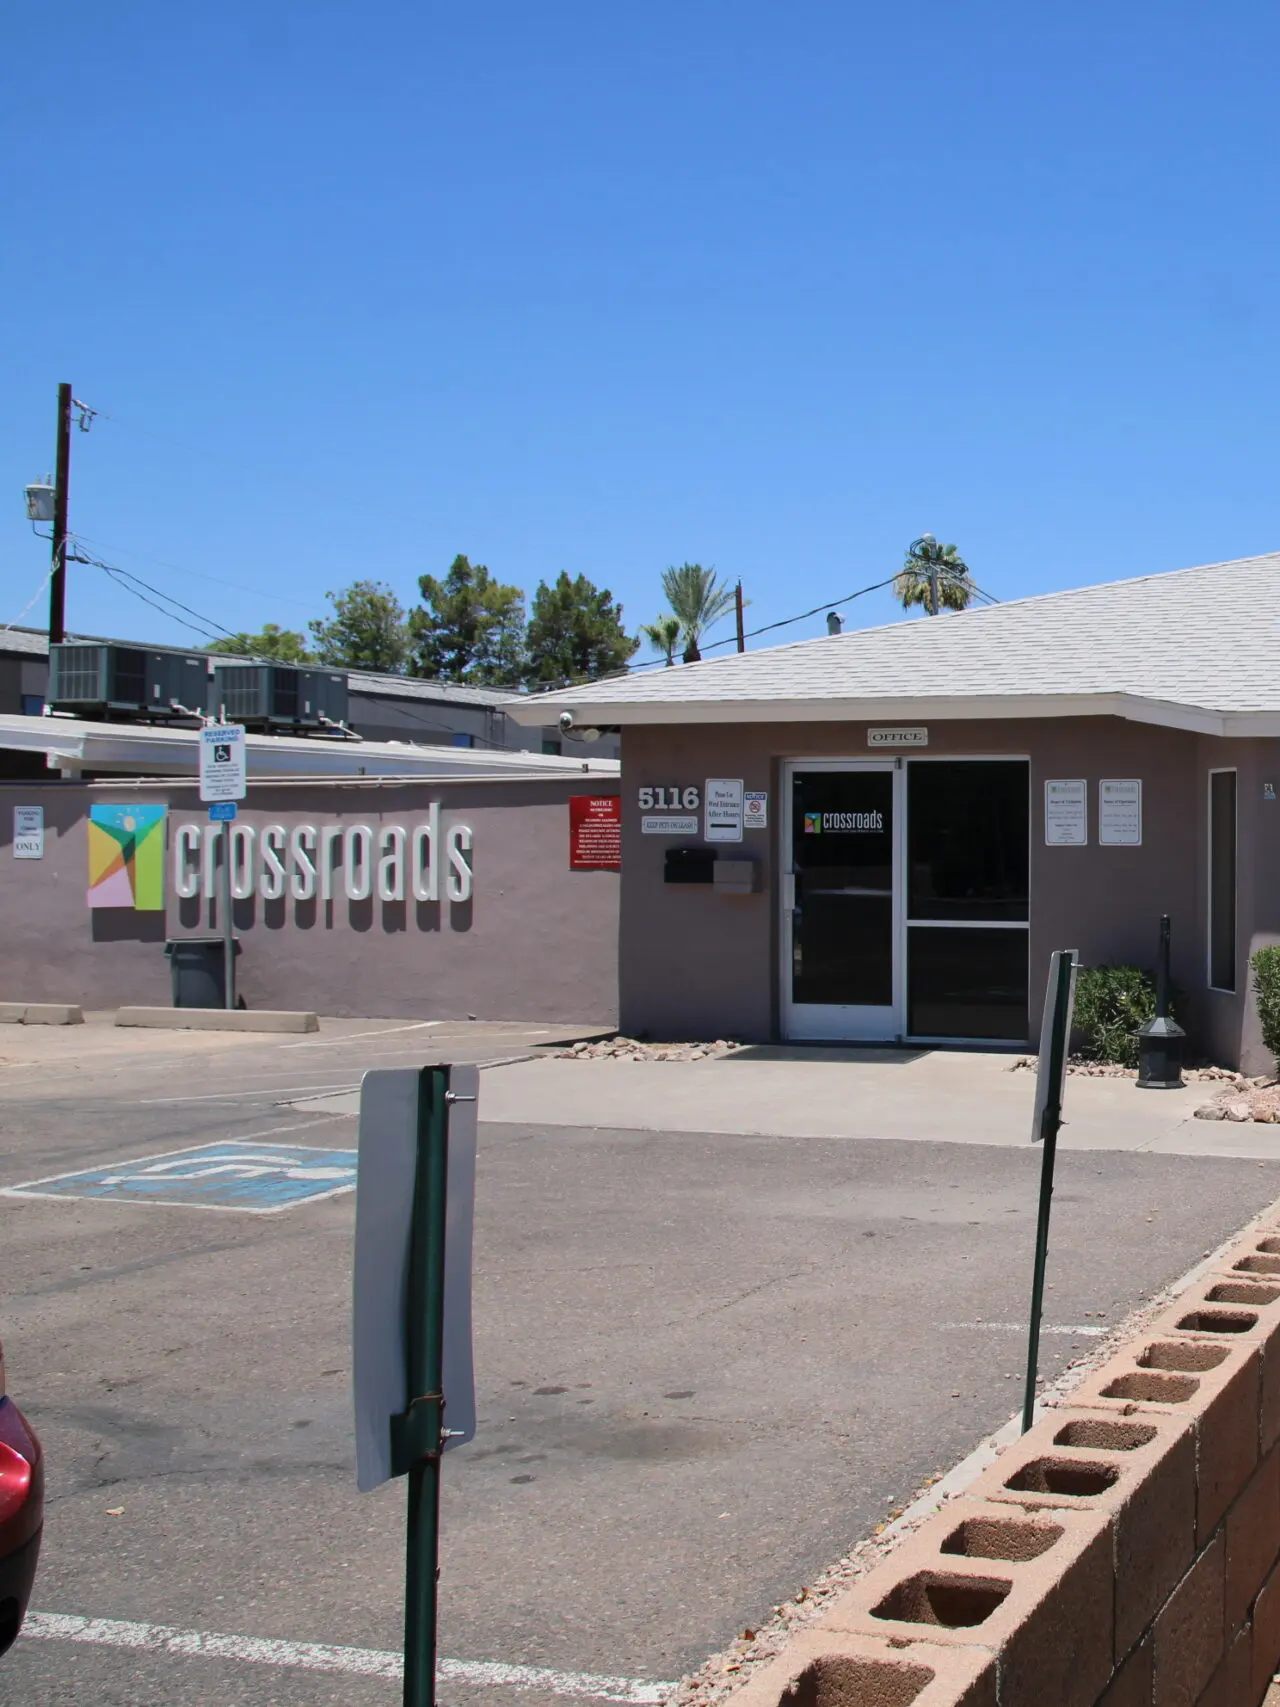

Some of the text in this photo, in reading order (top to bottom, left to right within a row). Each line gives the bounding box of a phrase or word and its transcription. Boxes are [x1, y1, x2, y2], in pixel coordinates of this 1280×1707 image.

[872, 733, 922, 742] OFFICE
[638, 787, 700, 810] 5116
[723, 810, 741, 818] Hours
[823, 809, 883, 829] crossroads
[16, 842, 40, 851] ONLY
[175, 803, 473, 902] crossroads
